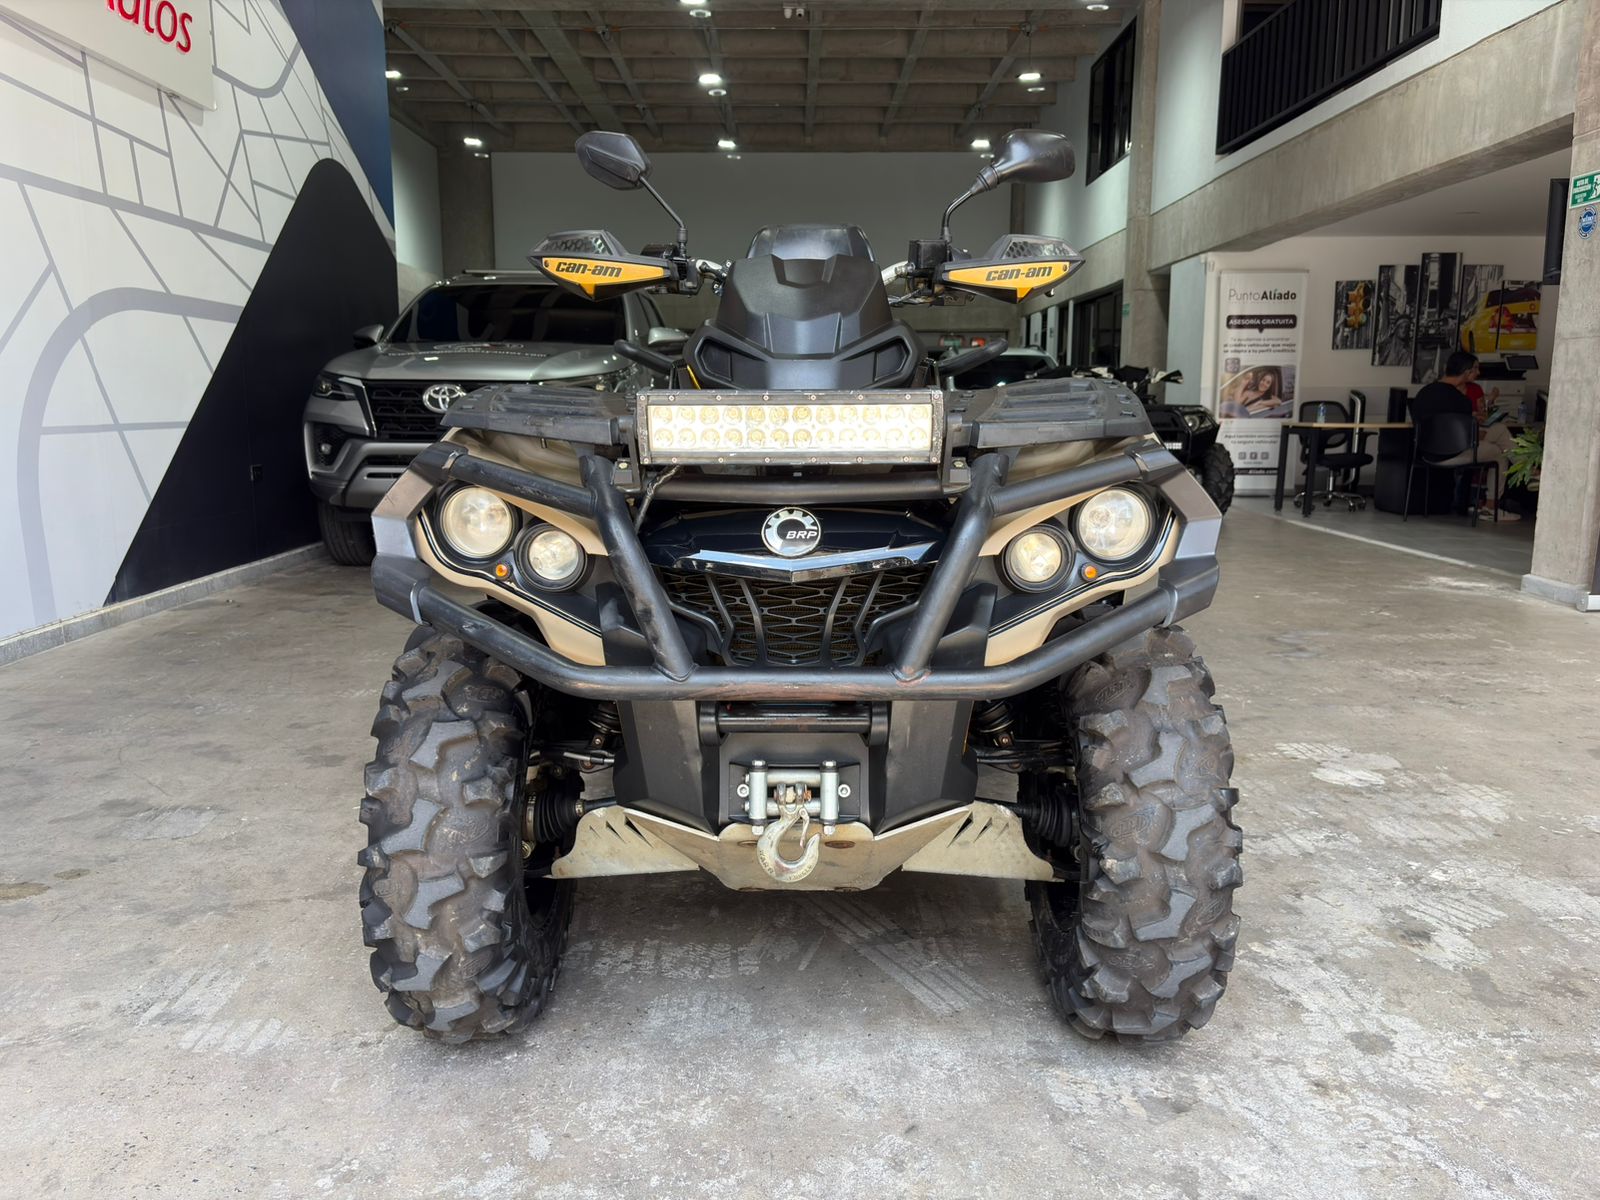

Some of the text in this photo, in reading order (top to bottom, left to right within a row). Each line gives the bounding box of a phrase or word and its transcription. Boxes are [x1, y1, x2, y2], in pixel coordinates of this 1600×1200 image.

[106, 0, 193, 53] utos
[555, 261, 622, 278] can-am
[985, 266, 1053, 282] can-am
[786, 530, 818, 540] BRP
